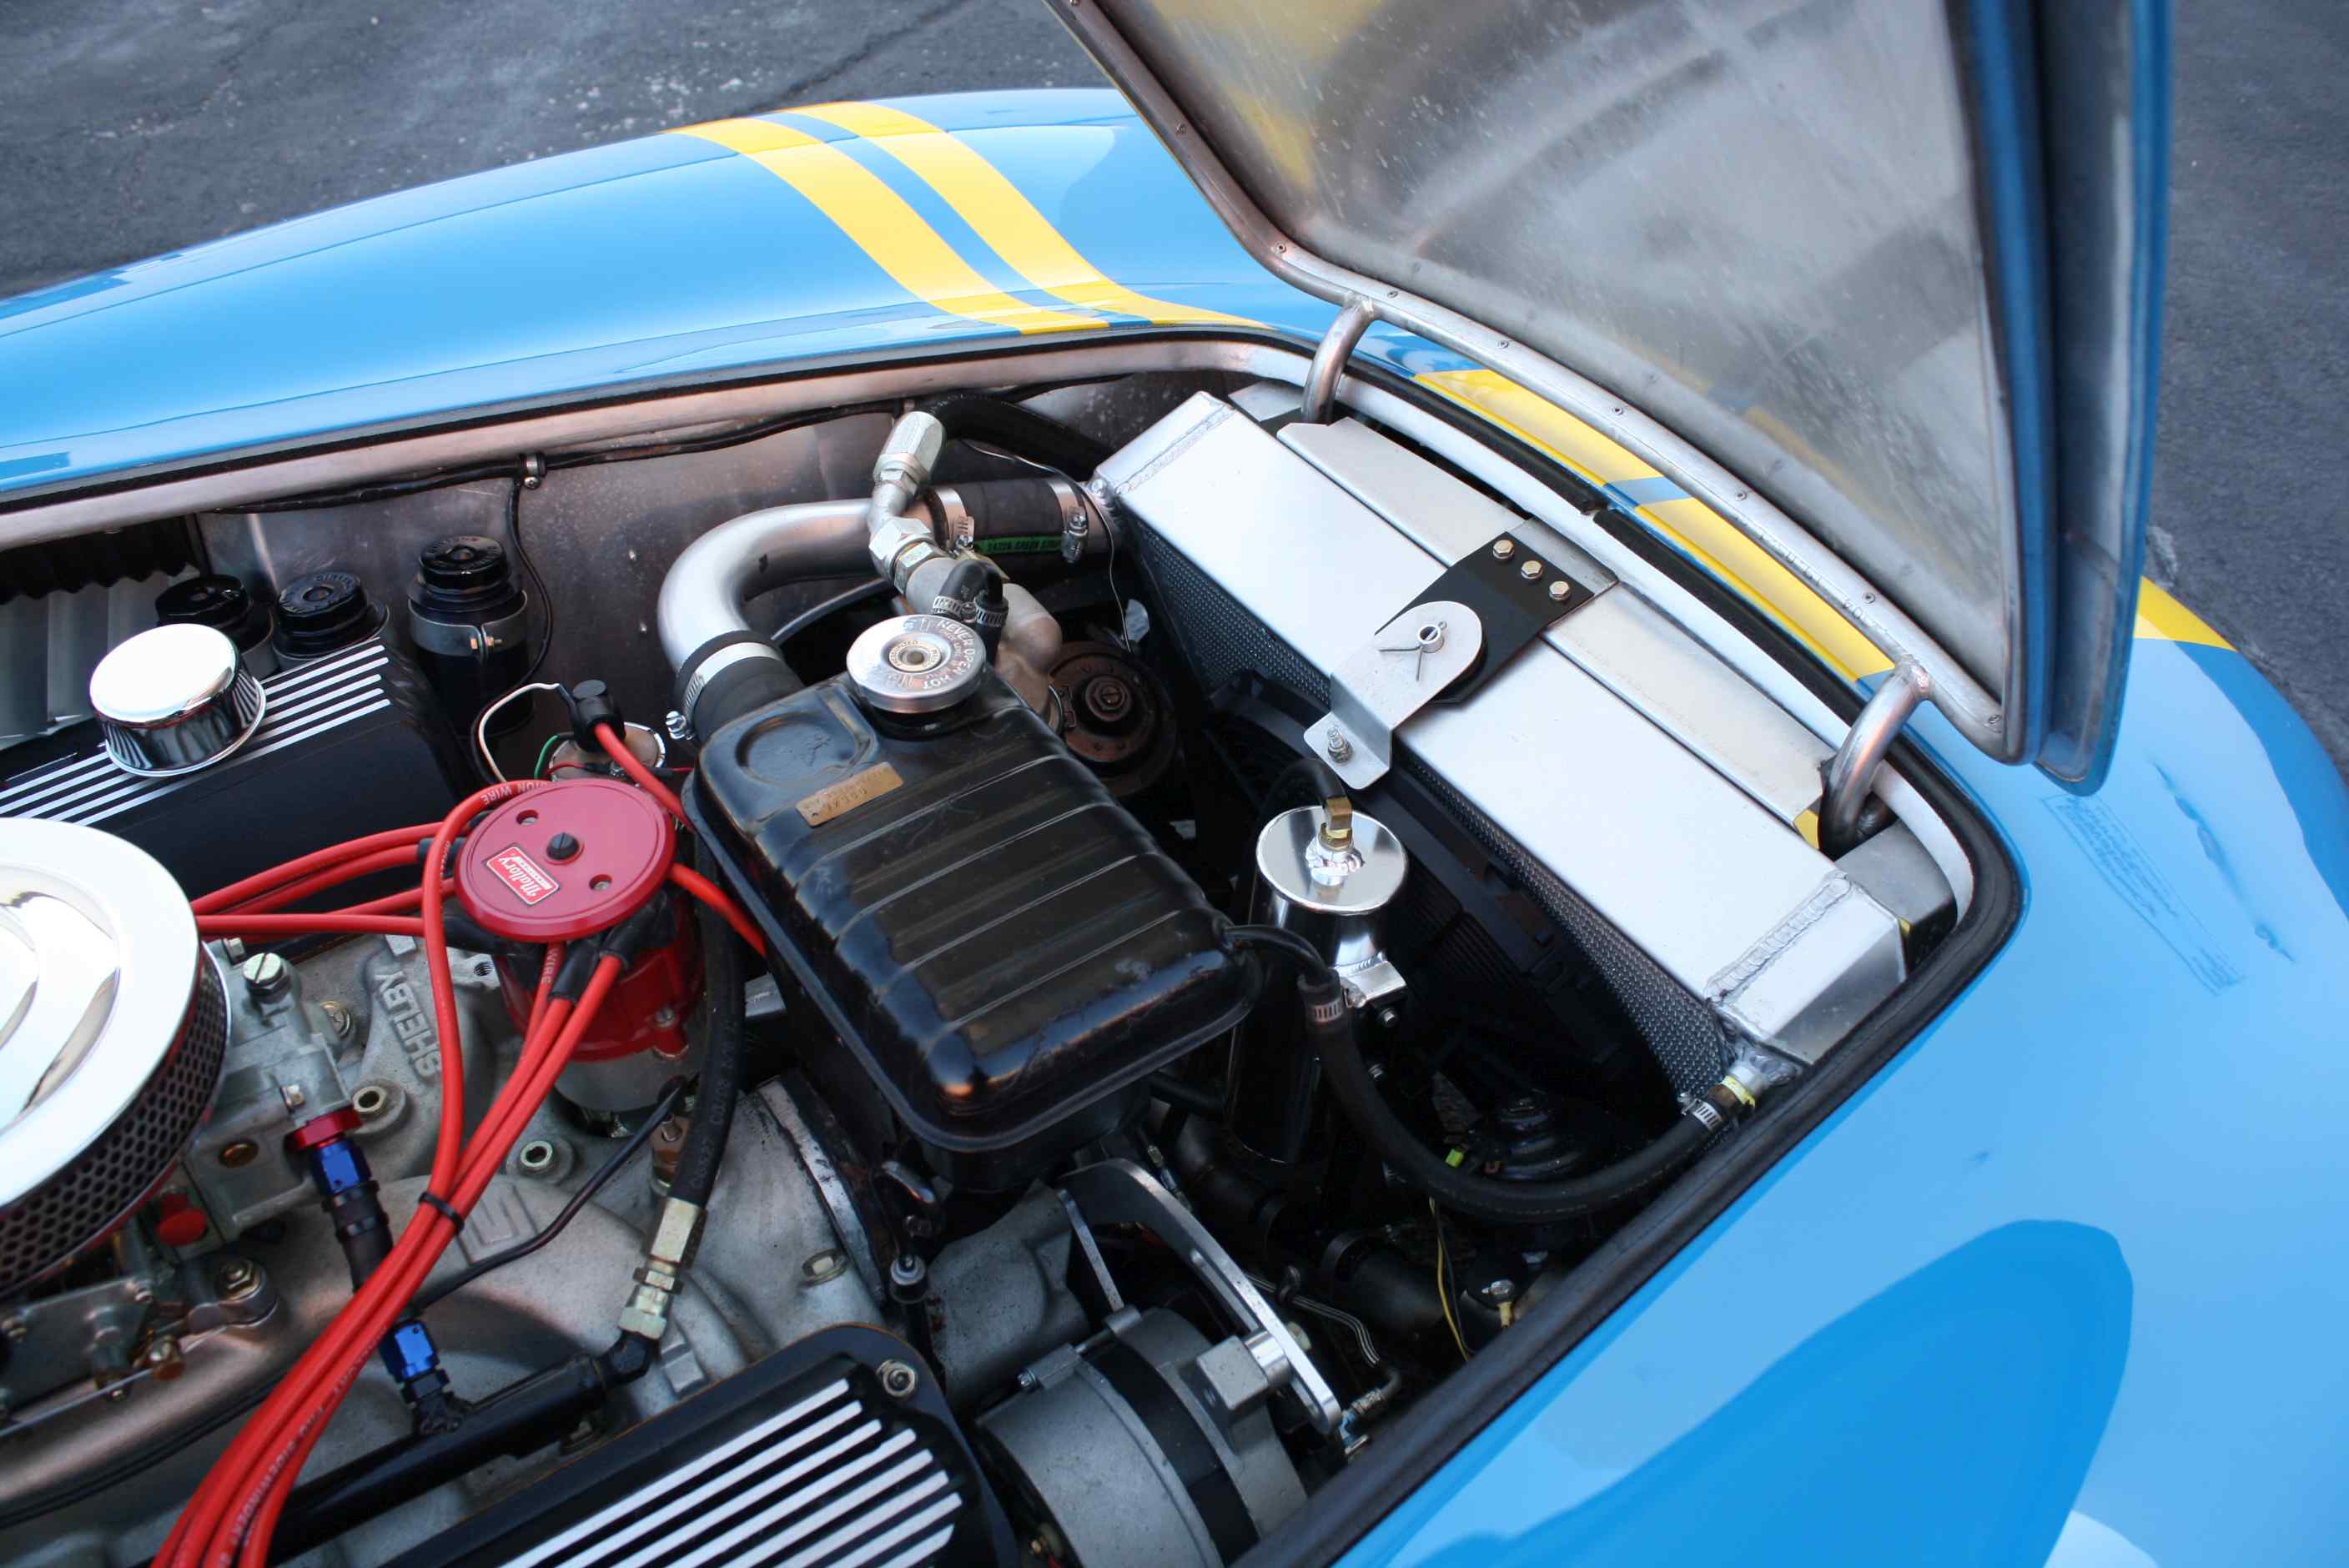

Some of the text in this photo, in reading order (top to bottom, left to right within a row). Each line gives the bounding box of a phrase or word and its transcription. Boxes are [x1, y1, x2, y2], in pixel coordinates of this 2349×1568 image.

[937, 619, 974, 646] NEVER
[953, 648, 975, 675] OPEN
[923, 674, 952, 689] HOT
[481, 786, 513, 805] WIRE
[497, 857, 542, 897] Mallory
[541, 947, 560, 984] WIRE
[375, 970, 441, 1077] SHELBY
